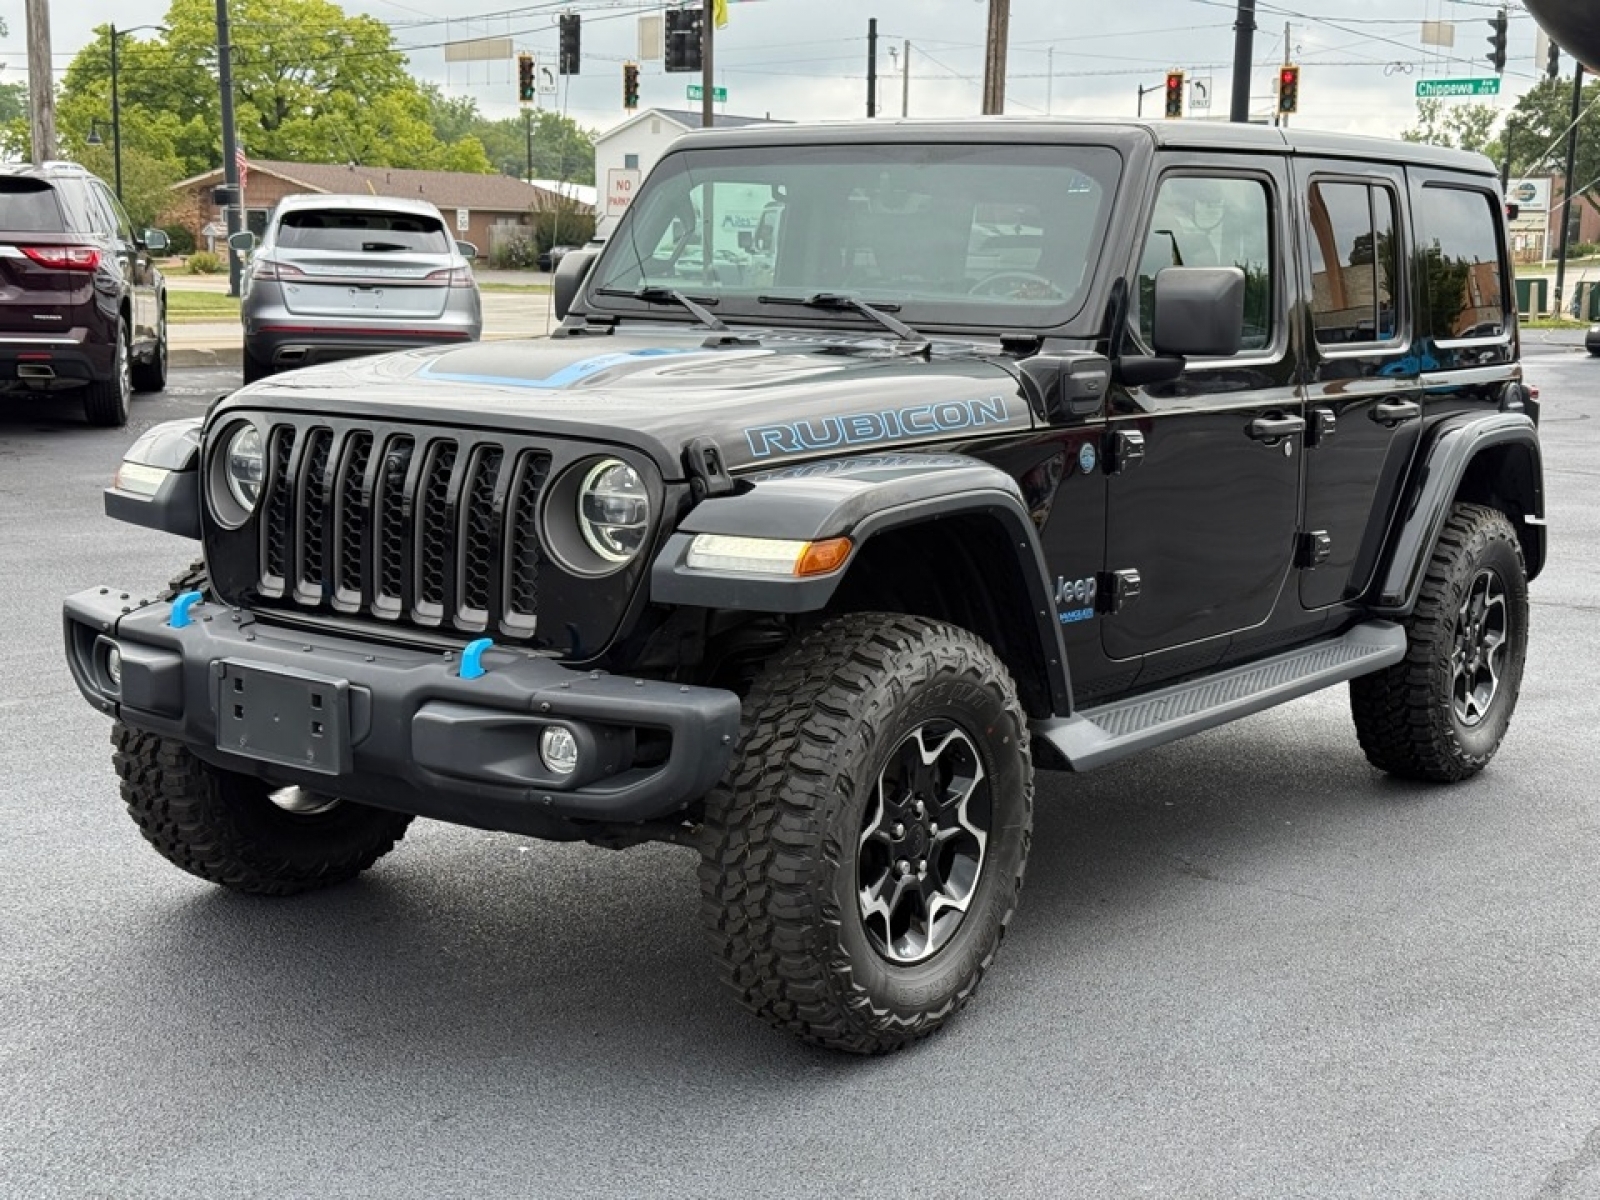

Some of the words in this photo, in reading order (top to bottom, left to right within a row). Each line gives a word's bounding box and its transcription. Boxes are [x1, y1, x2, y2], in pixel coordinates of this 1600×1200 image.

[1418, 82, 1474, 97] Chippewa
[616, 179, 631, 191] NO
[745, 396, 1009, 457] RUBICON
[1055, 575, 1097, 605] Jeep
